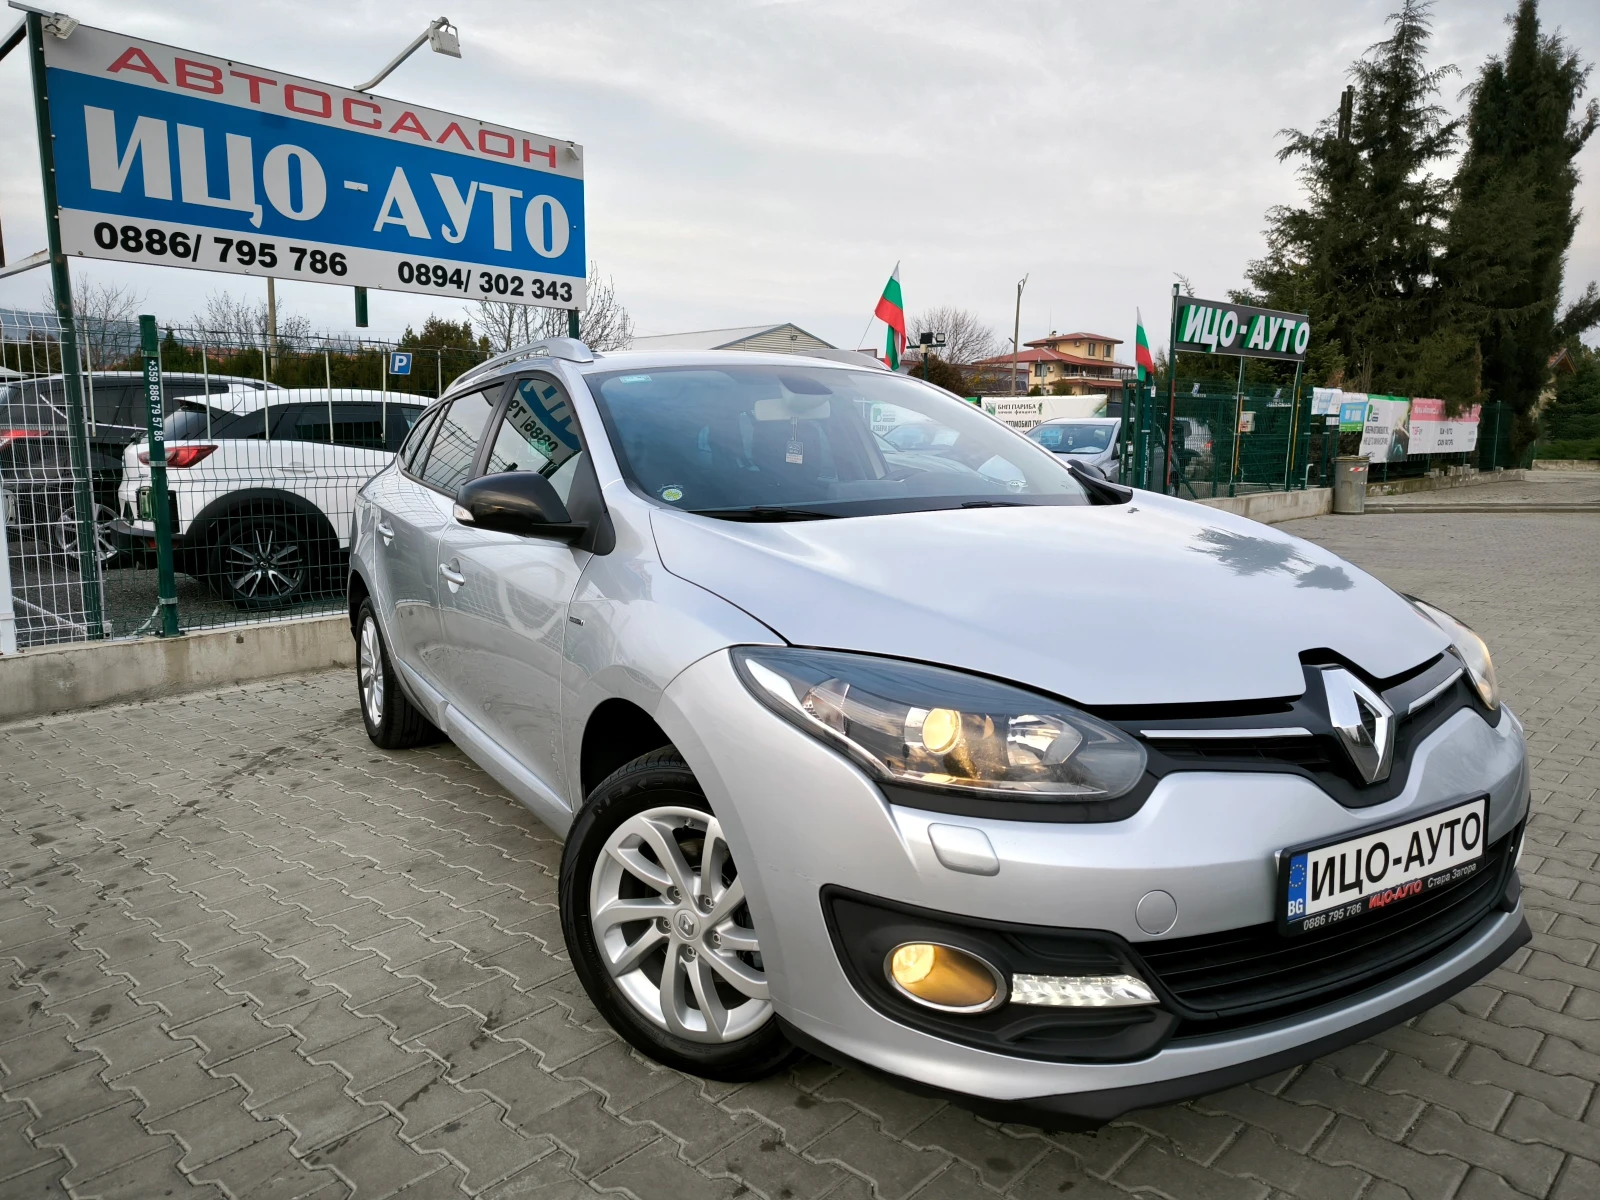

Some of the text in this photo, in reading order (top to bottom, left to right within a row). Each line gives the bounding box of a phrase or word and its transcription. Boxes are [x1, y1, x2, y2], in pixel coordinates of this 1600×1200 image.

[107, 46, 556, 169] АВТОСАЛОН
[94, 222, 348, 277] 0886/ 795 786
[397, 261, 573, 303] 0894/ 302 343
[1179, 304, 1309, 354] ИЦО-АУТО
[394, 355, 407, 372] P
[148, 360, 163, 441] +359 886 79 57 86
[1312, 811, 1481, 902] ИЦО-АУТО
[1287, 899, 1304, 917] BG
[1303, 861, 1477, 931] 0886 795 786 ИЦО-АУТО Стара Загора
